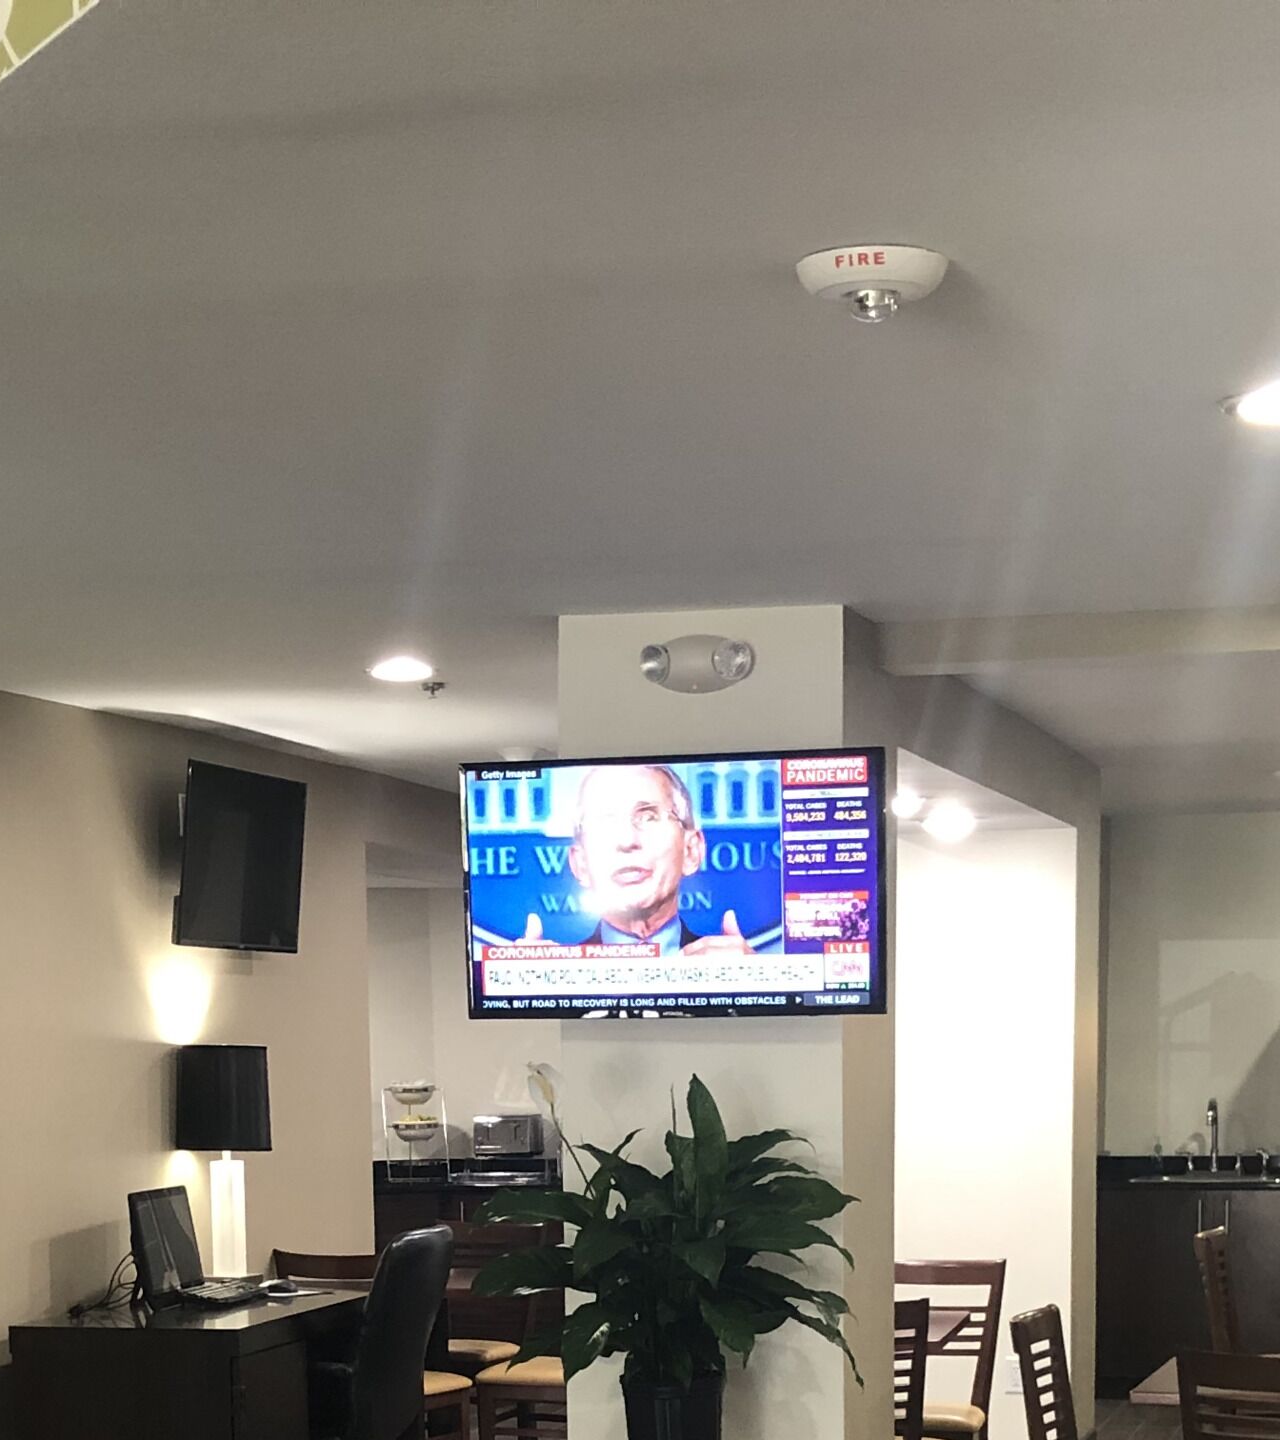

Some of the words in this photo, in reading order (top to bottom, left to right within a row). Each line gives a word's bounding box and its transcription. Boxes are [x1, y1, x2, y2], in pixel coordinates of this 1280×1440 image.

[834, 252, 886, 268] FIRE
[481, 770, 504, 780] Getty
[786, 769, 865, 783] PANDEMIC
[488, 947, 583, 960] CORONAVIRUS
[586, 945, 656, 957] PANDEMIC
[829, 943, 864, 954] LIVE
[513, 1000, 529, 1008] BUT
[532, 999, 556, 1008] ROAD
[559, 999, 570, 1008] TO
[572, 998, 617, 1008] RECOVERY
[620, 998, 628, 1007] IS
[631, 998, 655, 1007] LONG
[657, 998, 675, 1006] AND
[678, 997, 707, 1006] FILLED
[710, 997, 733, 1006] WITH
[735, 996, 786, 1005] OBSTACLES
[815, 995, 833, 1004] THE
[835, 995, 859, 1004] LEAD
